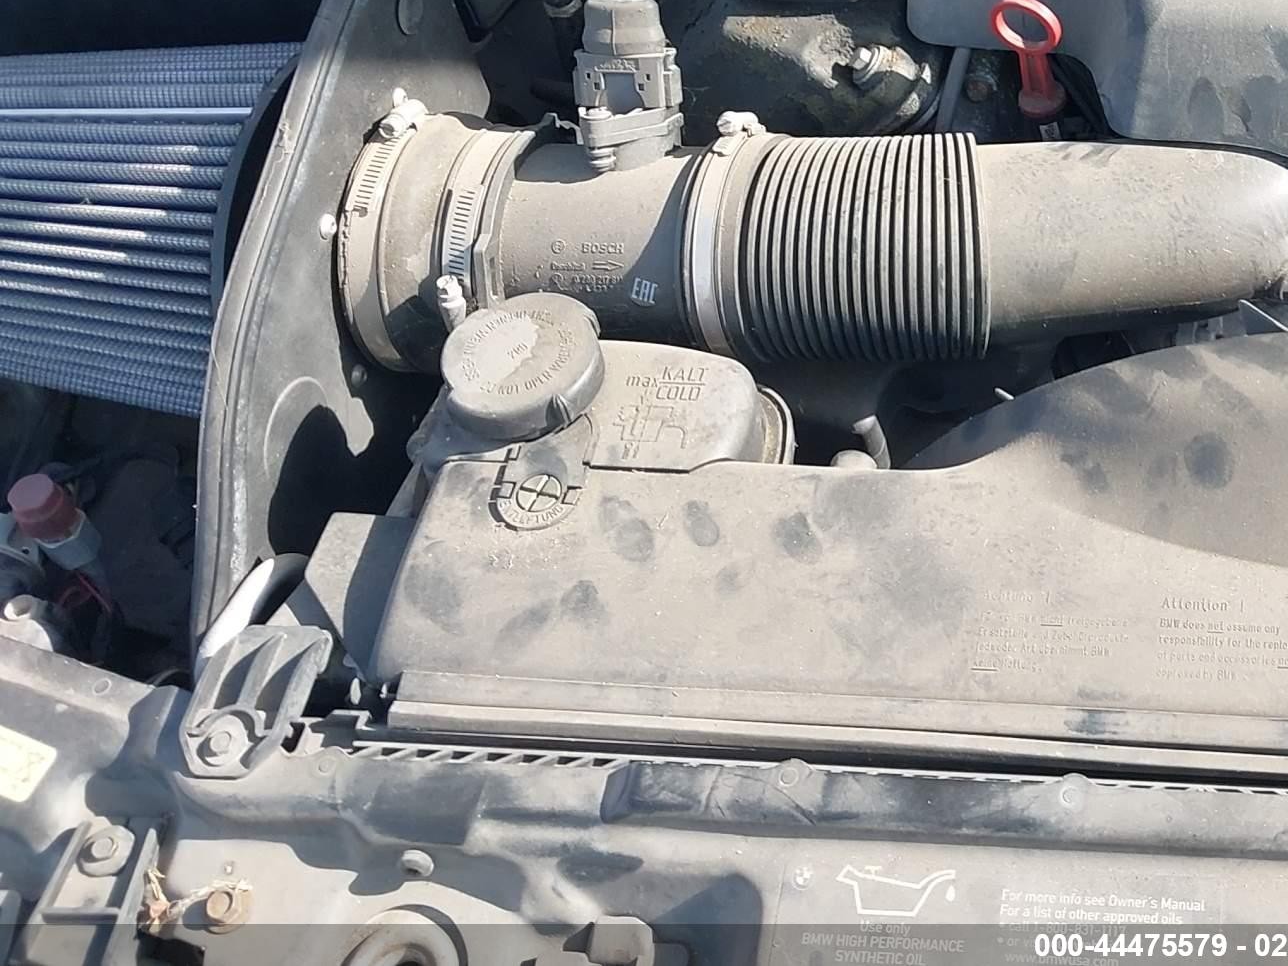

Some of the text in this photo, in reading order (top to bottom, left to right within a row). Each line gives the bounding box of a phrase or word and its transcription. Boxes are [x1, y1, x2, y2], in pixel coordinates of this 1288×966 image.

[582, 242, 624, 253] BOSCH
[626, 366, 709, 388] max KALT
[656, 385, 701, 401] COLD
[1161, 597, 1228, 612] Attention
[1160, 618, 1180, 629] BMW
[1183, 619, 1205, 630] does
[1207, 620, 1224, 633] not
[1159, 635, 1224, 648] responsibility
[1227, 637, 1241, 647] for
[1246, 638, 1261, 649] the
[1001, 889, 1023, 901] For
[1025, 893, 1056, 904] more
[1059, 892, 1082, 904] info
[1084, 895, 1105, 906] see
[1161, 897, 1206, 912] Manual
[999, 904, 1020, 916] For
[1022, 908, 1030, 917] a
[1033, 905, 1051, 918] list
[1055, 907, 1066, 919] of
[1069, 909, 1100, 921] other
[1103, 911, 1159, 924] approved
[860, 920, 910, 936] Use only
[801, 932, 965, 952] BMW HIGH PERFORMANCE
[835, 950, 926, 966] SYNTHETIC OIL
